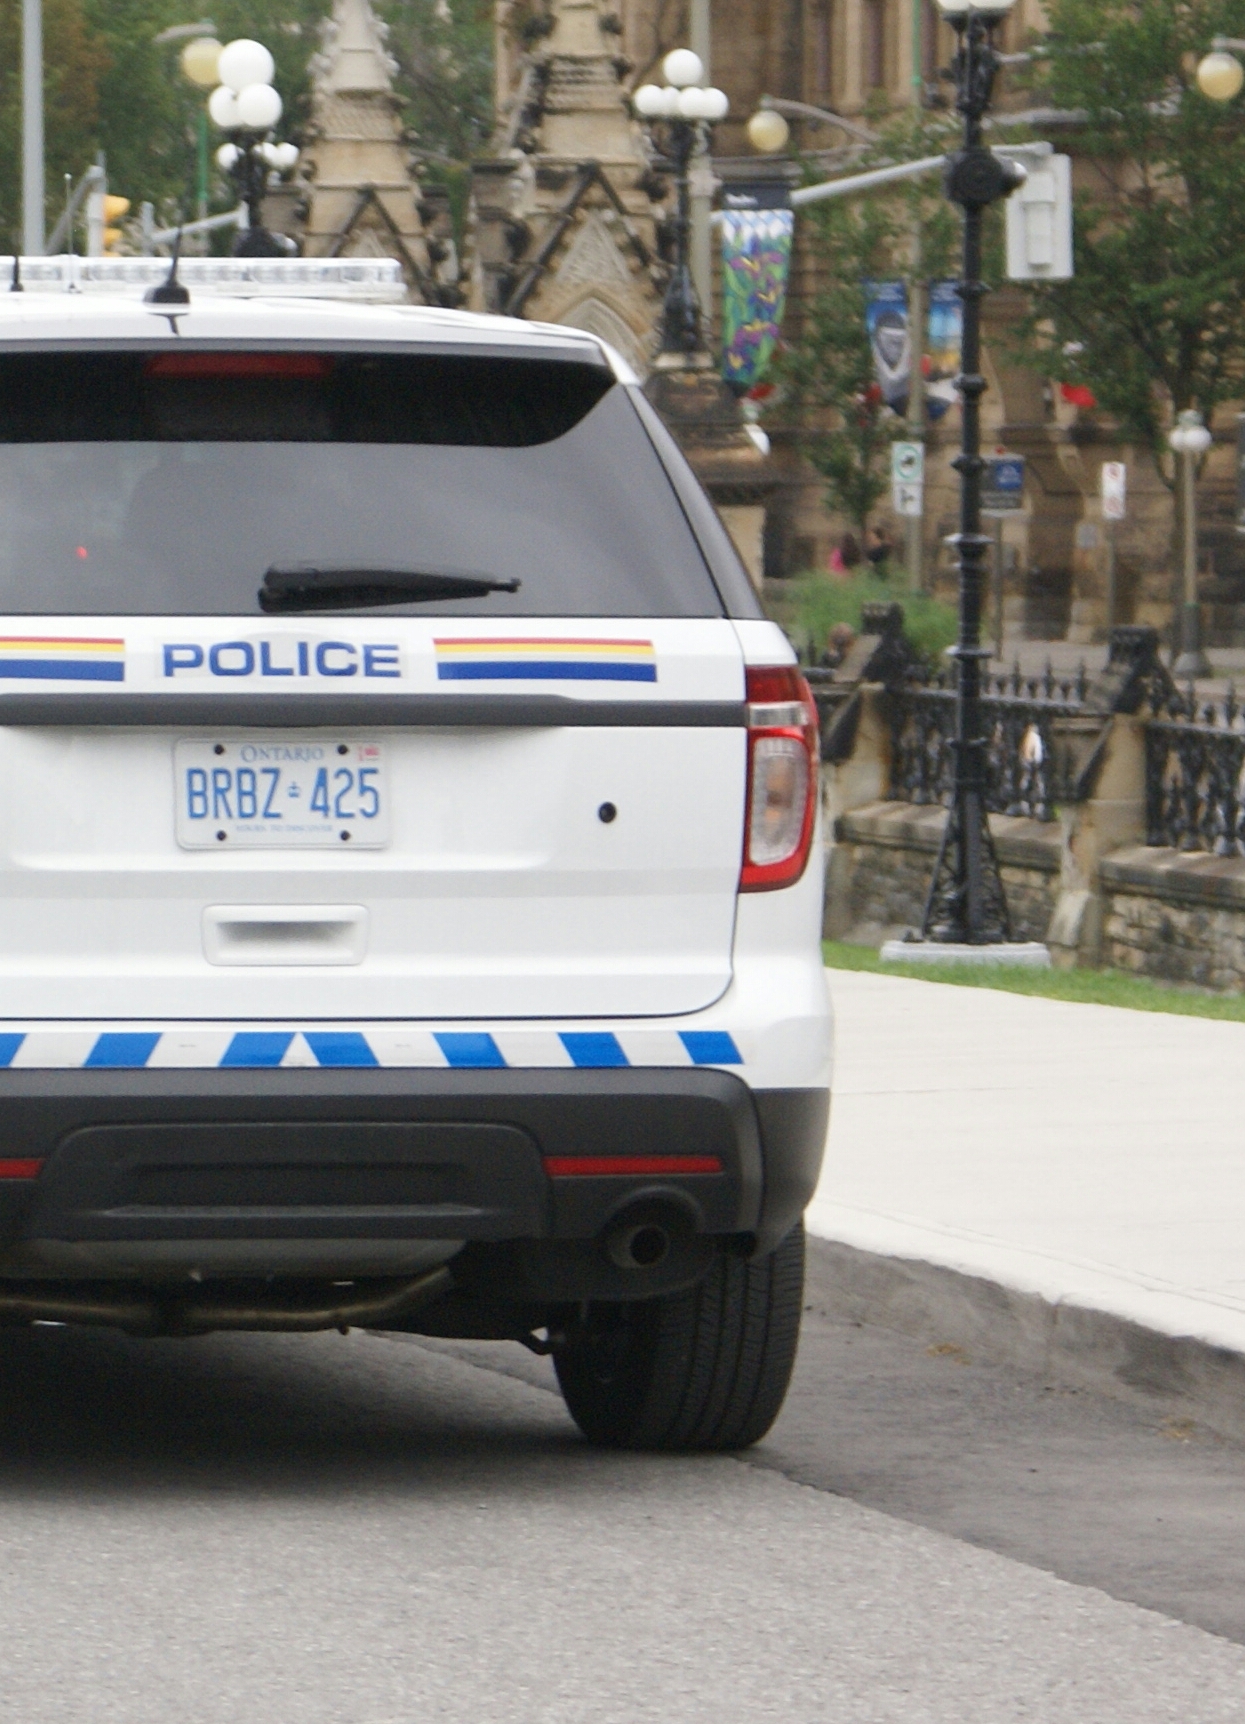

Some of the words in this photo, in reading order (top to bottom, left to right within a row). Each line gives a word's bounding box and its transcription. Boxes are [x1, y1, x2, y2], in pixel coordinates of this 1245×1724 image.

[162, 641, 401, 677] POLICE
[240, 744, 324, 763] ONTARIO
[186, 767, 282, 819] BRBZ
[310, 767, 379, 819] 425
